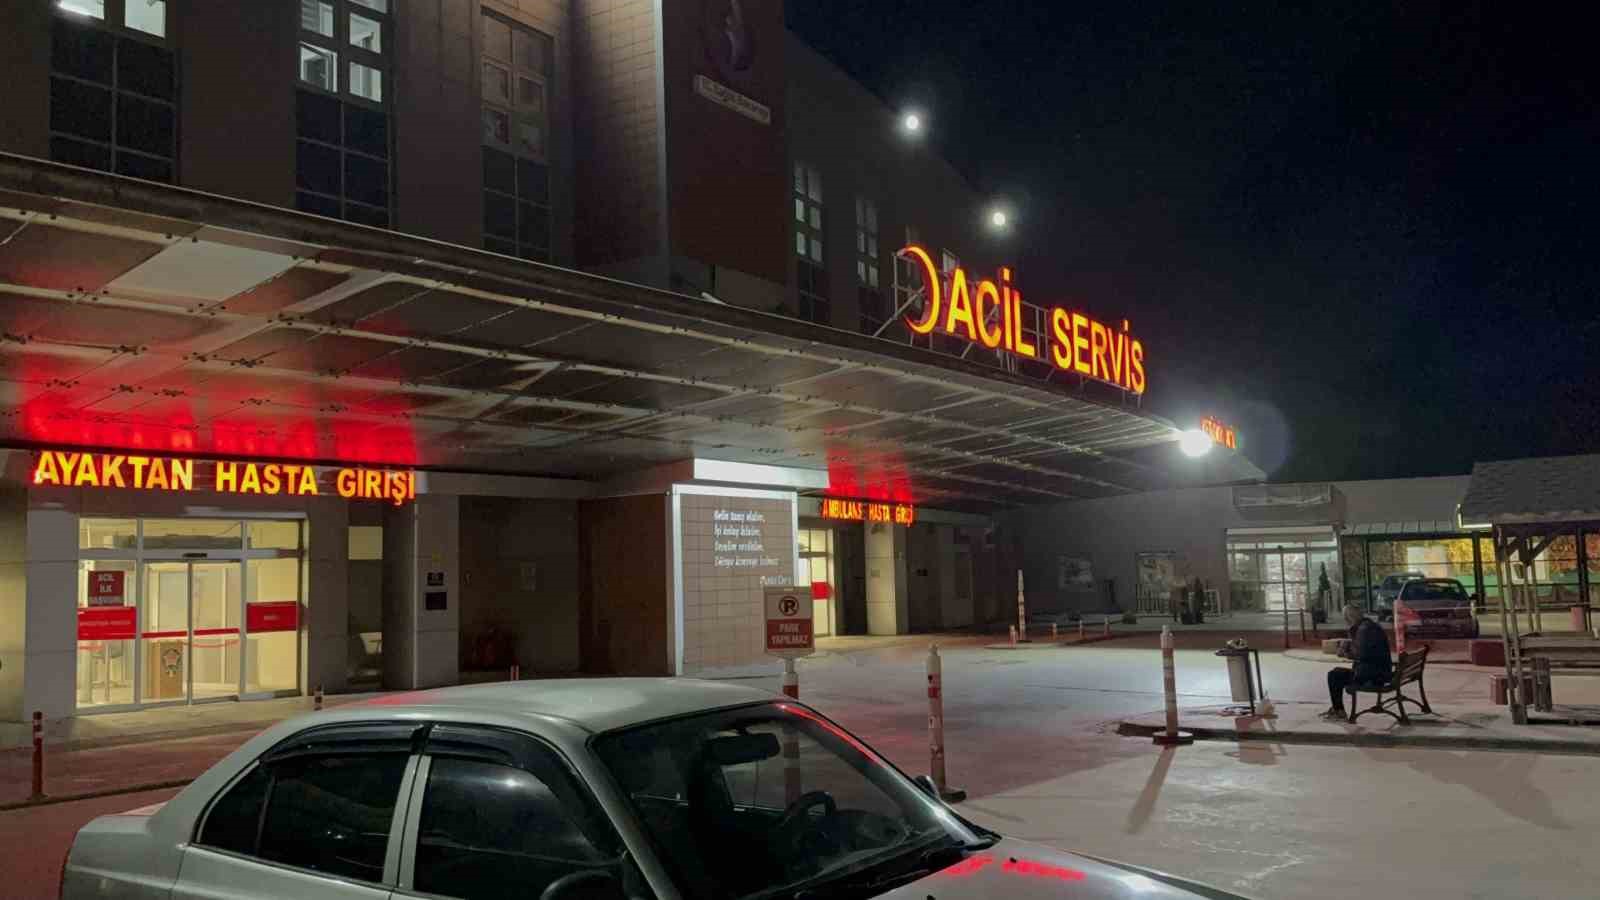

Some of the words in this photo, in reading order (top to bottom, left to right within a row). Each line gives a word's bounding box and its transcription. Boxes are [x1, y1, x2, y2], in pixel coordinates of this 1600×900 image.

[946, 266, 1036, 357] ACİL
[1052, 307, 1146, 394] SERVİS
[33, 451, 193, 491] AYAKTAN
[215, 461, 319, 496] HASTA
[778, 623, 799, 633] PARK
